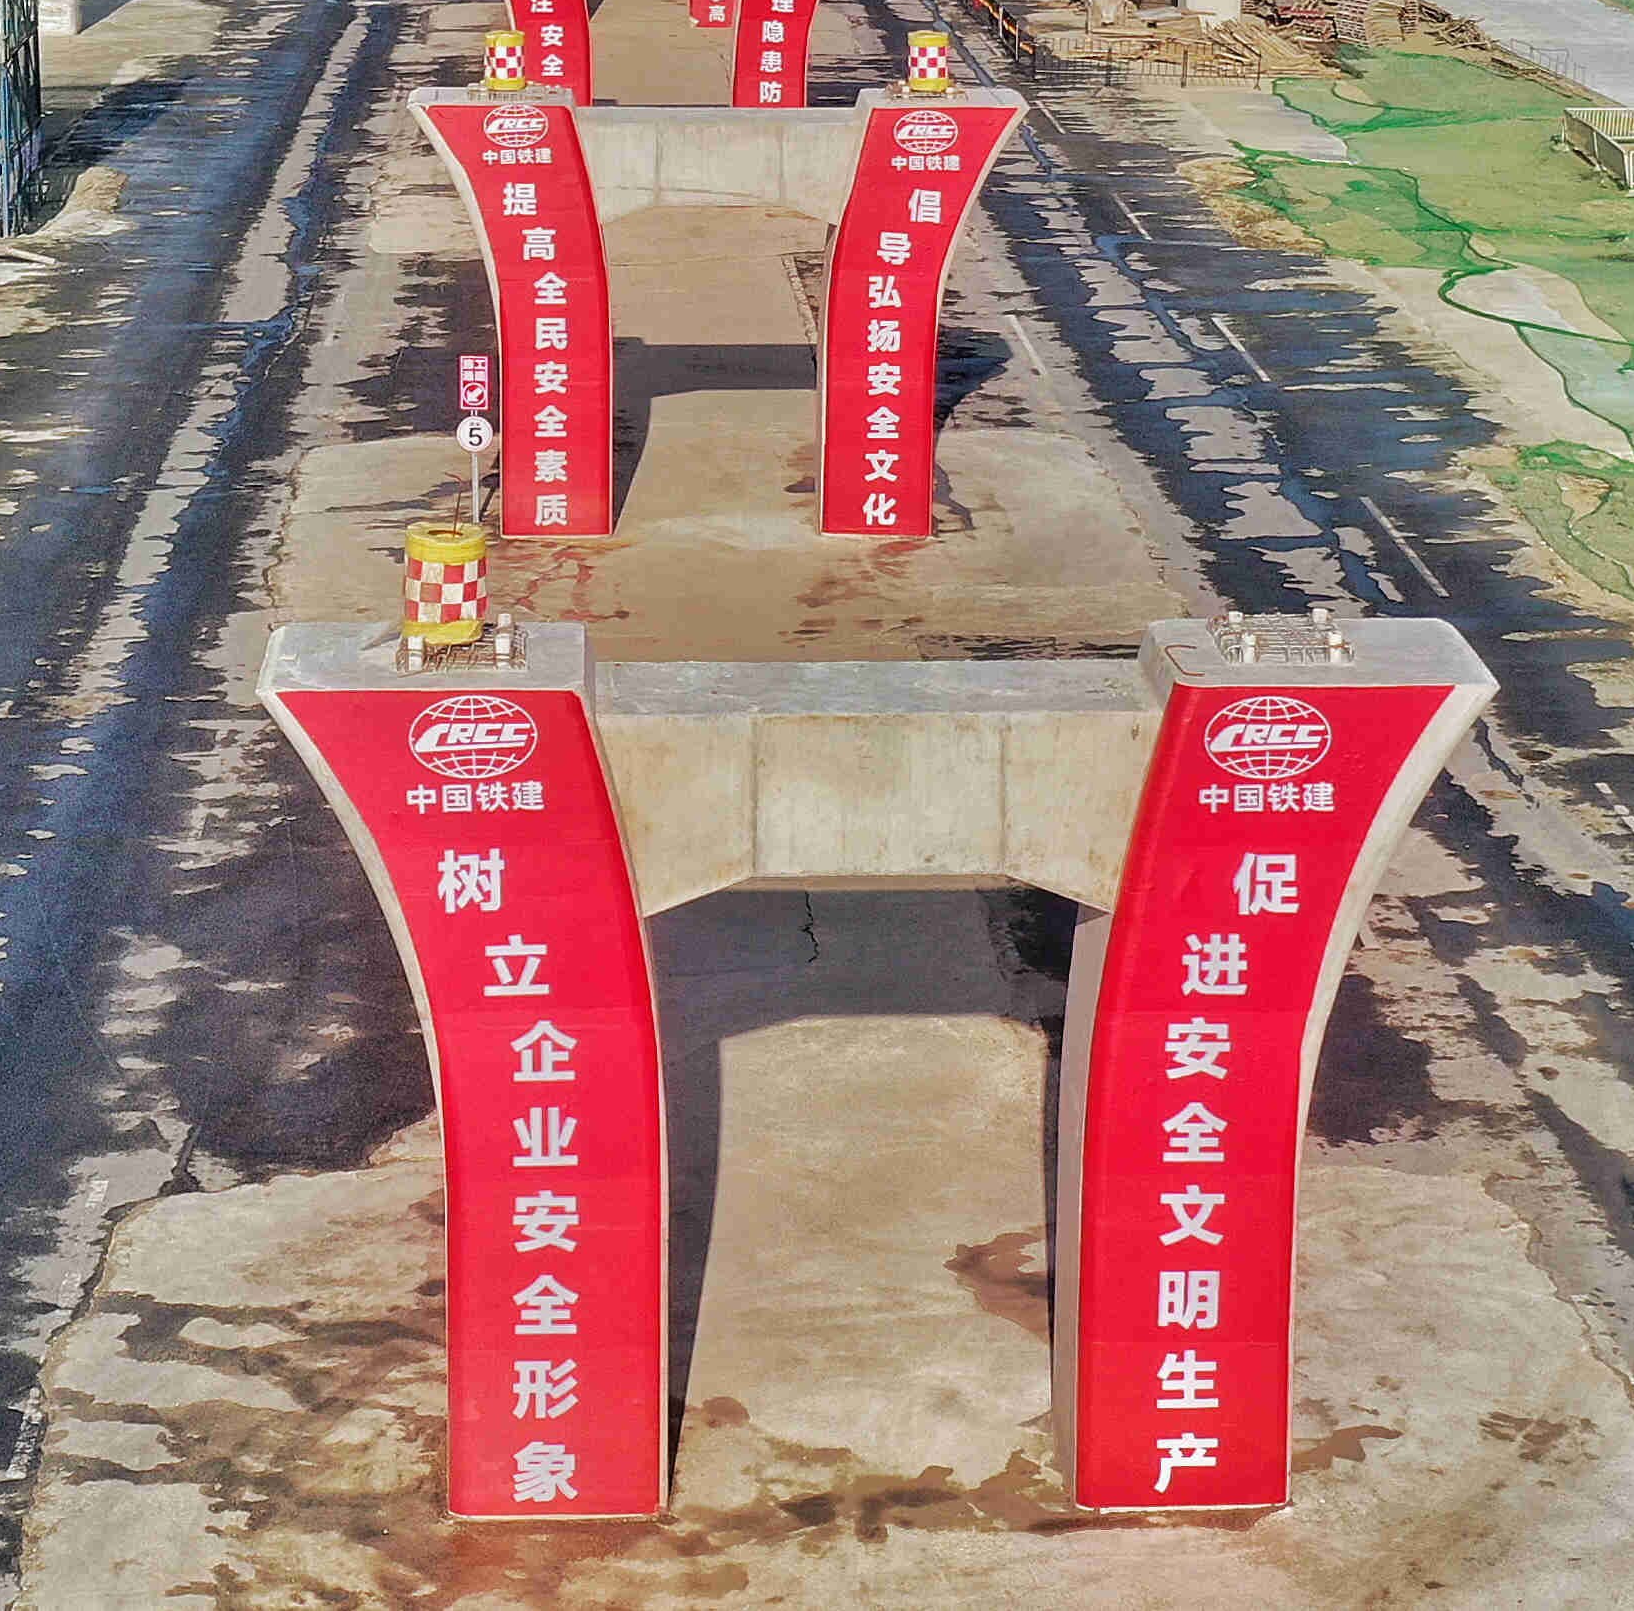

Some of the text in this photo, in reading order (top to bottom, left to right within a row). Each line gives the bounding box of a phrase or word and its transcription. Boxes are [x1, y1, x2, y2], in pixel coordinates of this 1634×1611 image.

[482, 148, 552, 165] 中国铁建
[891, 155, 960, 171] 中国铁建
[503, 182, 569, 527] 提高全民安全素质
[862, 188, 943, 526] 倡导弘扬安全文化
[468, 427, 483, 447] 5
[406, 780, 545, 815] 中国铁建
[1199, 781, 1335, 814] 中国铁建
[437, 848, 580, 1504] 树立企业安全形象
[1155, 852, 1300, 1495] 促进安全文明生产
